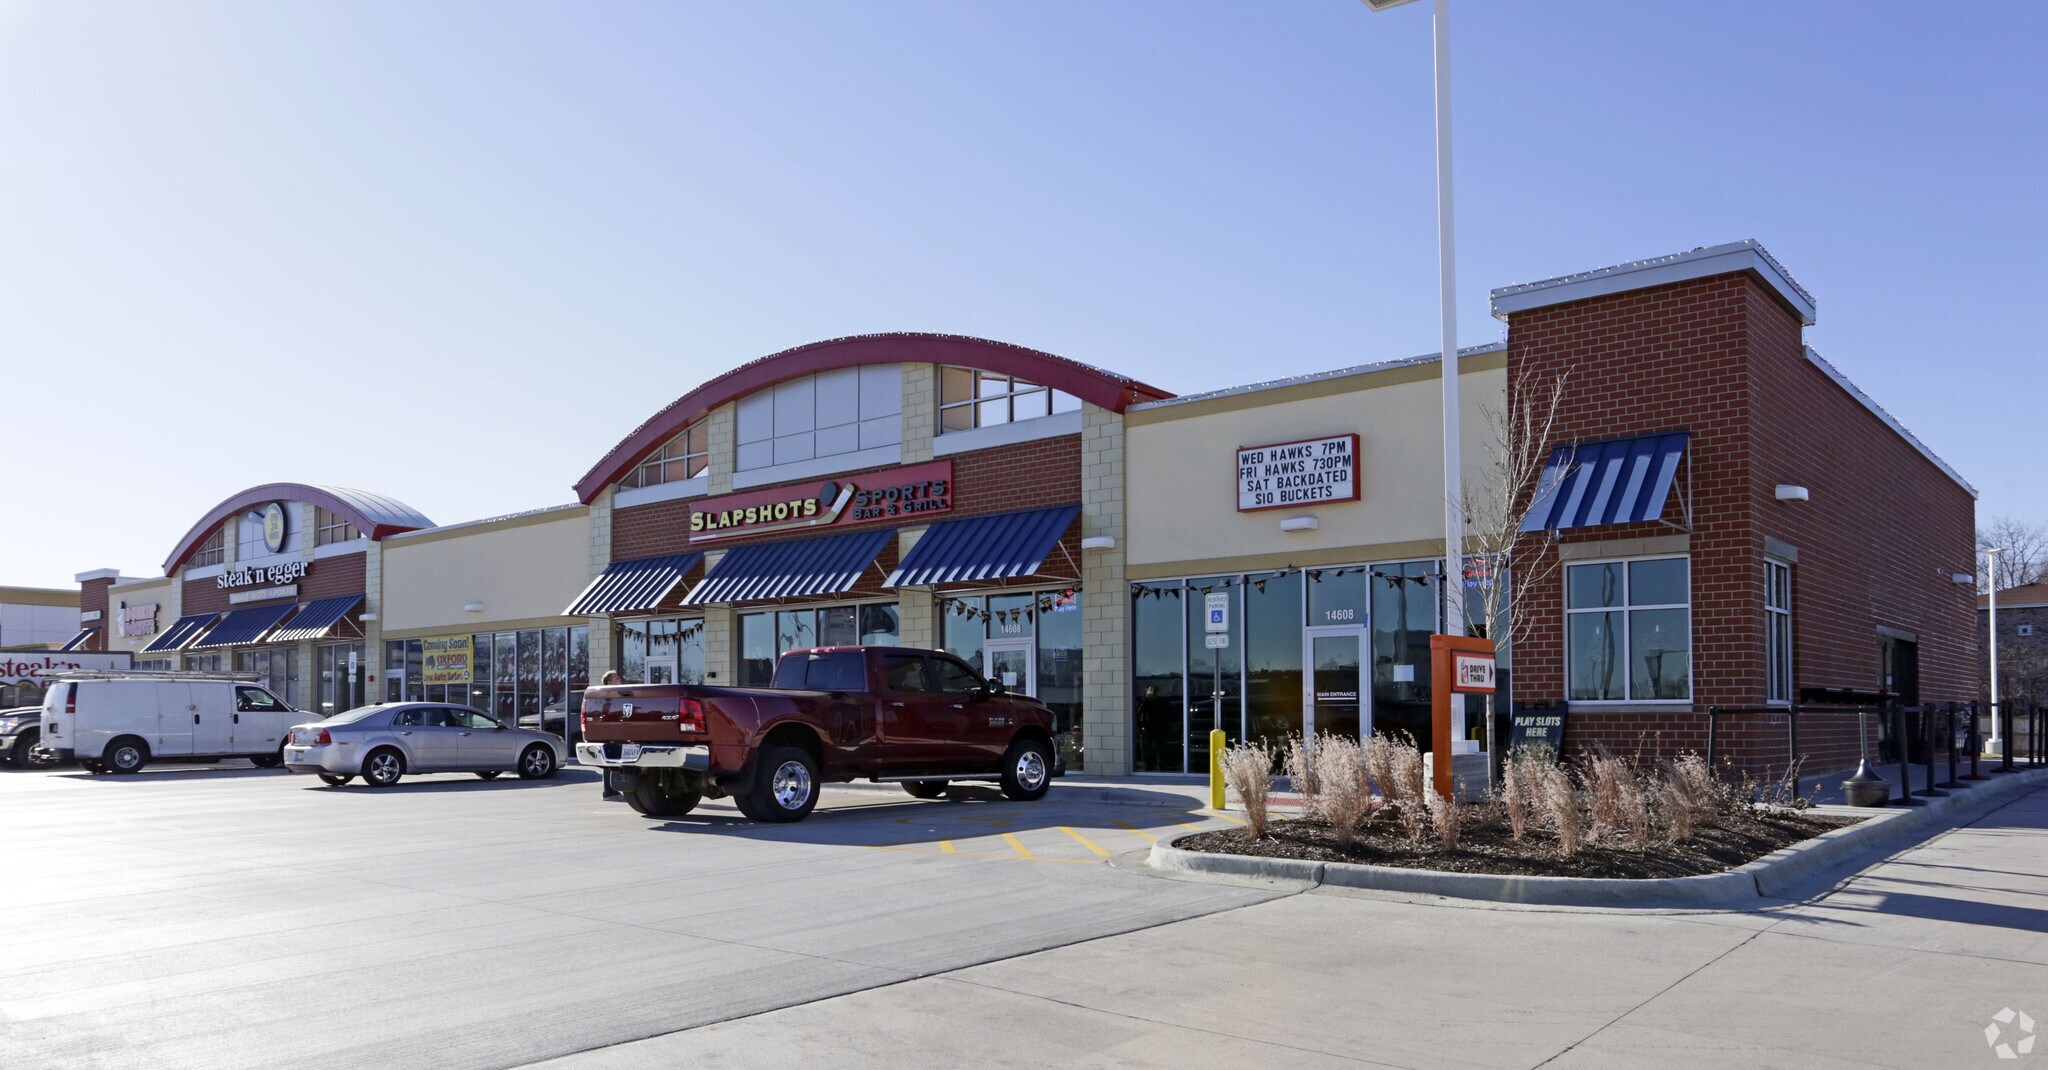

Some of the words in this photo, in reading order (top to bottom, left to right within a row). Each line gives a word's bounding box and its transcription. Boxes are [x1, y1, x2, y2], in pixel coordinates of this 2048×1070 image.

[1241, 452, 1264, 465] WED
[1270, 445, 1312, 462] HAWKS
[1321, 441, 1346, 455] 7PM
[1240, 467, 1257, 479] FRI
[1265, 460, 1305, 476] HAWKS
[1312, 455, 1352, 470] 730PM
[1247, 478, 1270, 492] SAT
[1277, 469, 1347, 489] BACKDATED
[1280, 485, 1333, 502] BUCKETS
[690, 498, 818, 532] SLAPSHOTS
[855, 480, 947, 507] SPORTS
[853, 507, 880, 520] BAR
[886, 504, 896, 515] &
[902, 498, 947, 512] GRILL
[271, 522, 279, 531] 24
[267, 561, 308, 585] egger
[1326, 609, 1354, 620] 14608
[1000, 624, 1021, 634] 14608
[423, 639, 448, 652] Coming
[448, 636, 469, 649] Soon!
[437, 653, 468, 665] OXFORD
[1469, 664, 1486, 673] DRIVE
[434, 672, 447, 681] Auto
[1469, 674, 1485, 682] THRU
[1514, 716, 1535, 727] PLAY
[1535, 716, 1561, 726] SLOTS
[1525, 727, 1548, 737] HERE
